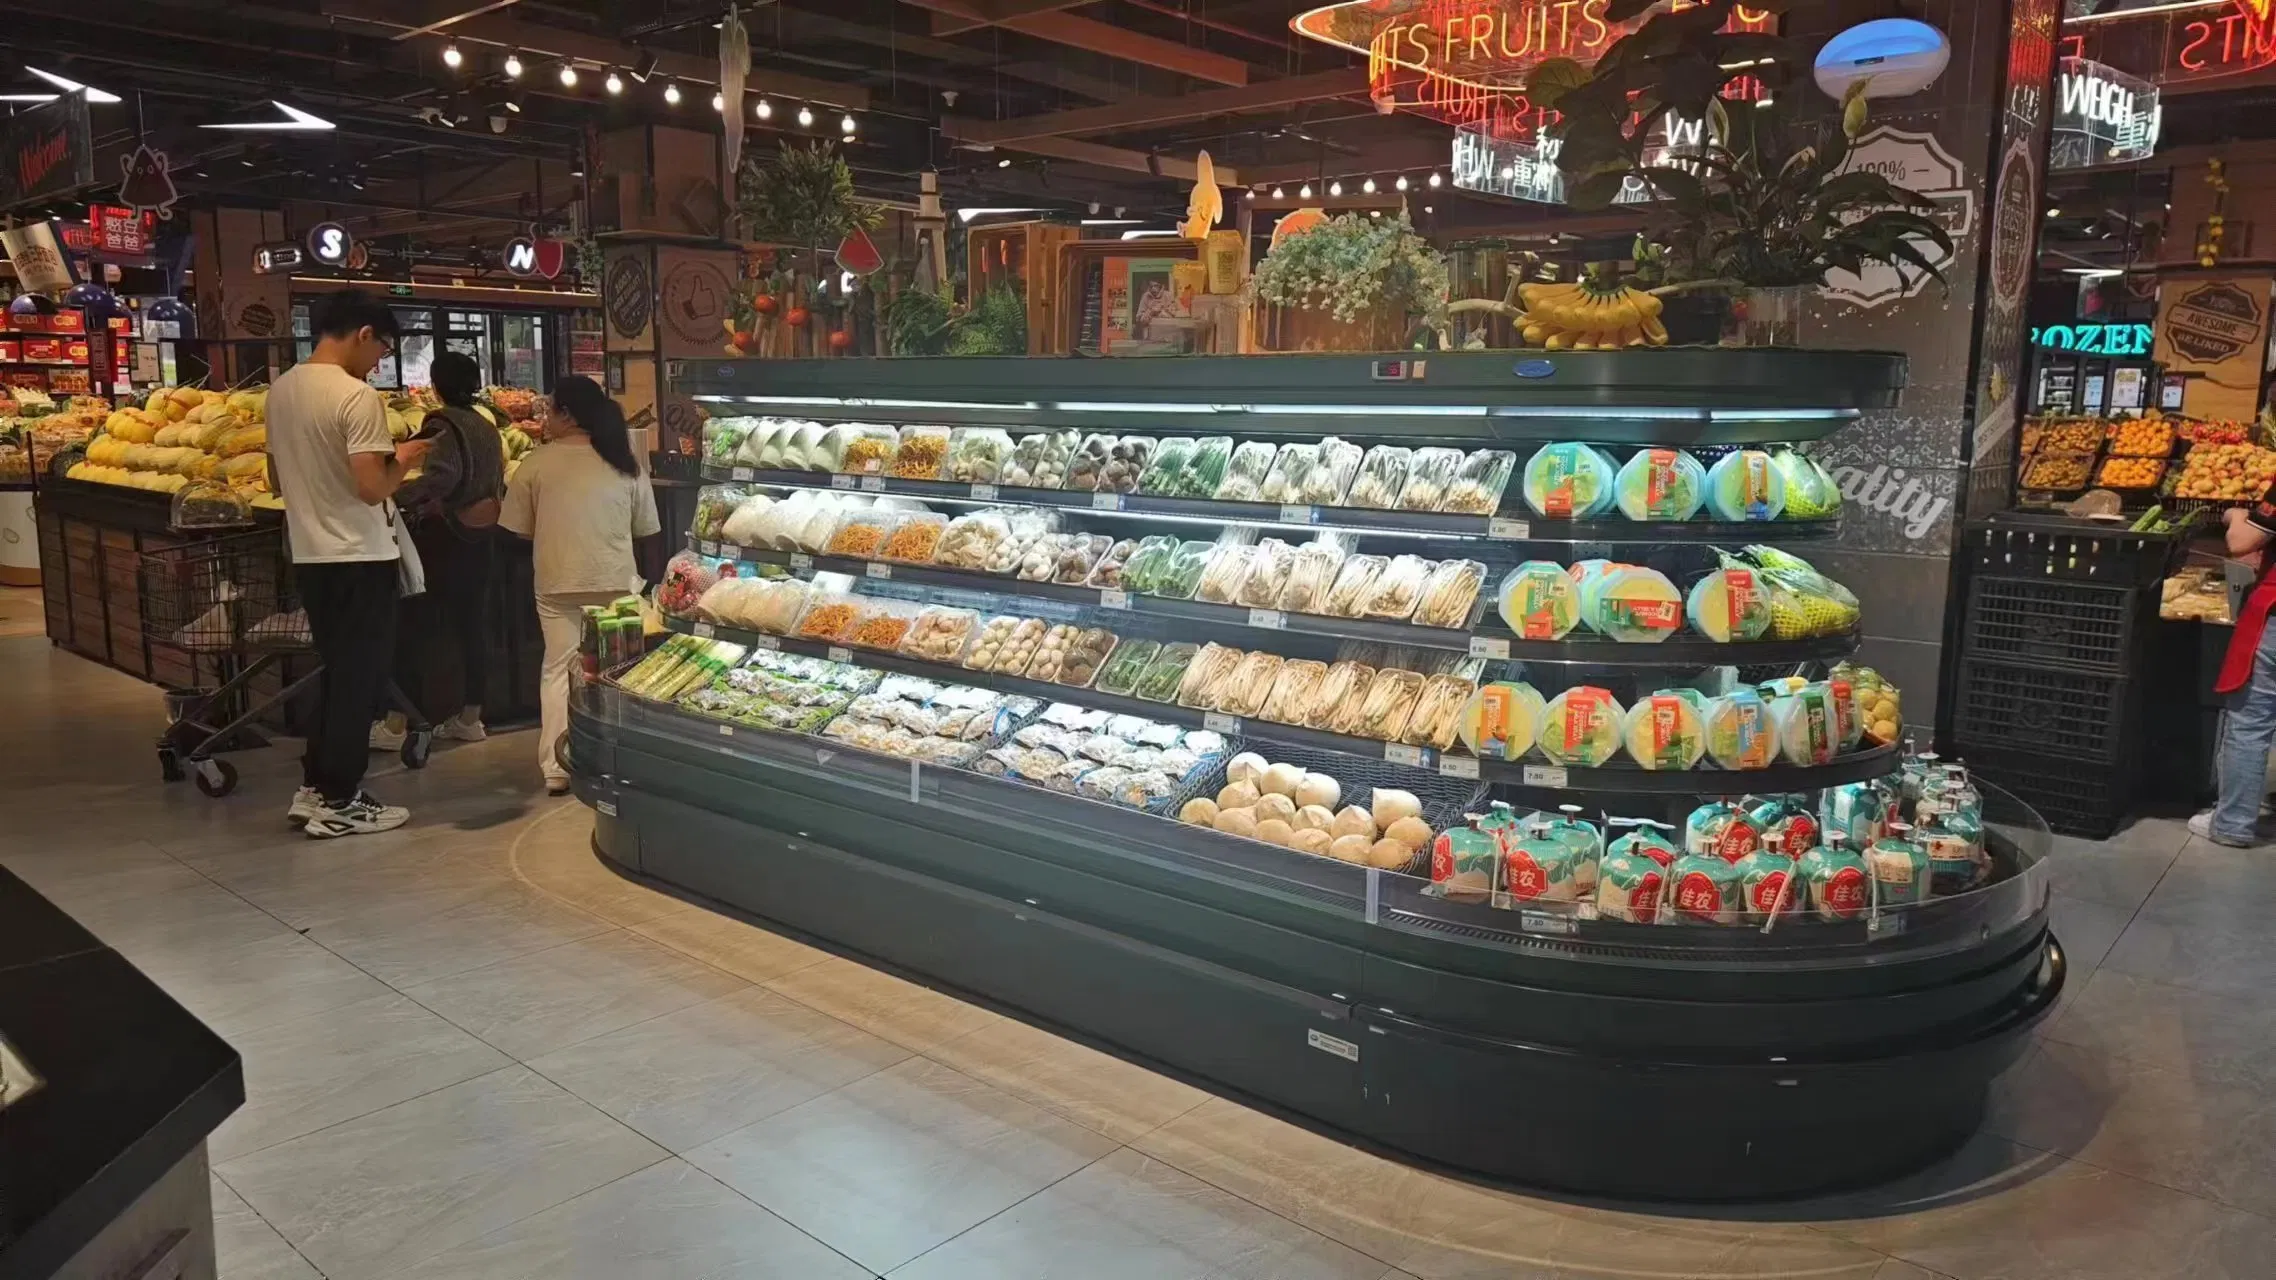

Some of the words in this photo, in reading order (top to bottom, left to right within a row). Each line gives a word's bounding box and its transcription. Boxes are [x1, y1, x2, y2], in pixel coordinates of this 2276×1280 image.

[1445, 0, 1608, 63] FRUITS
[2061, 73, 2134, 127] WEIGH
[320, 229, 343, 258] S
[510, 244, 534, 270] N
[2186, 313, 2239, 336] AWESOME
[2030, 323, 2153, 355] OZEN
[2193, 337, 2230, 353] LIKED
[1824, 460, 1950, 540] ality
[1680, 887, 1713, 910] 佳农
[1833, 884, 1865, 902] 佳农
